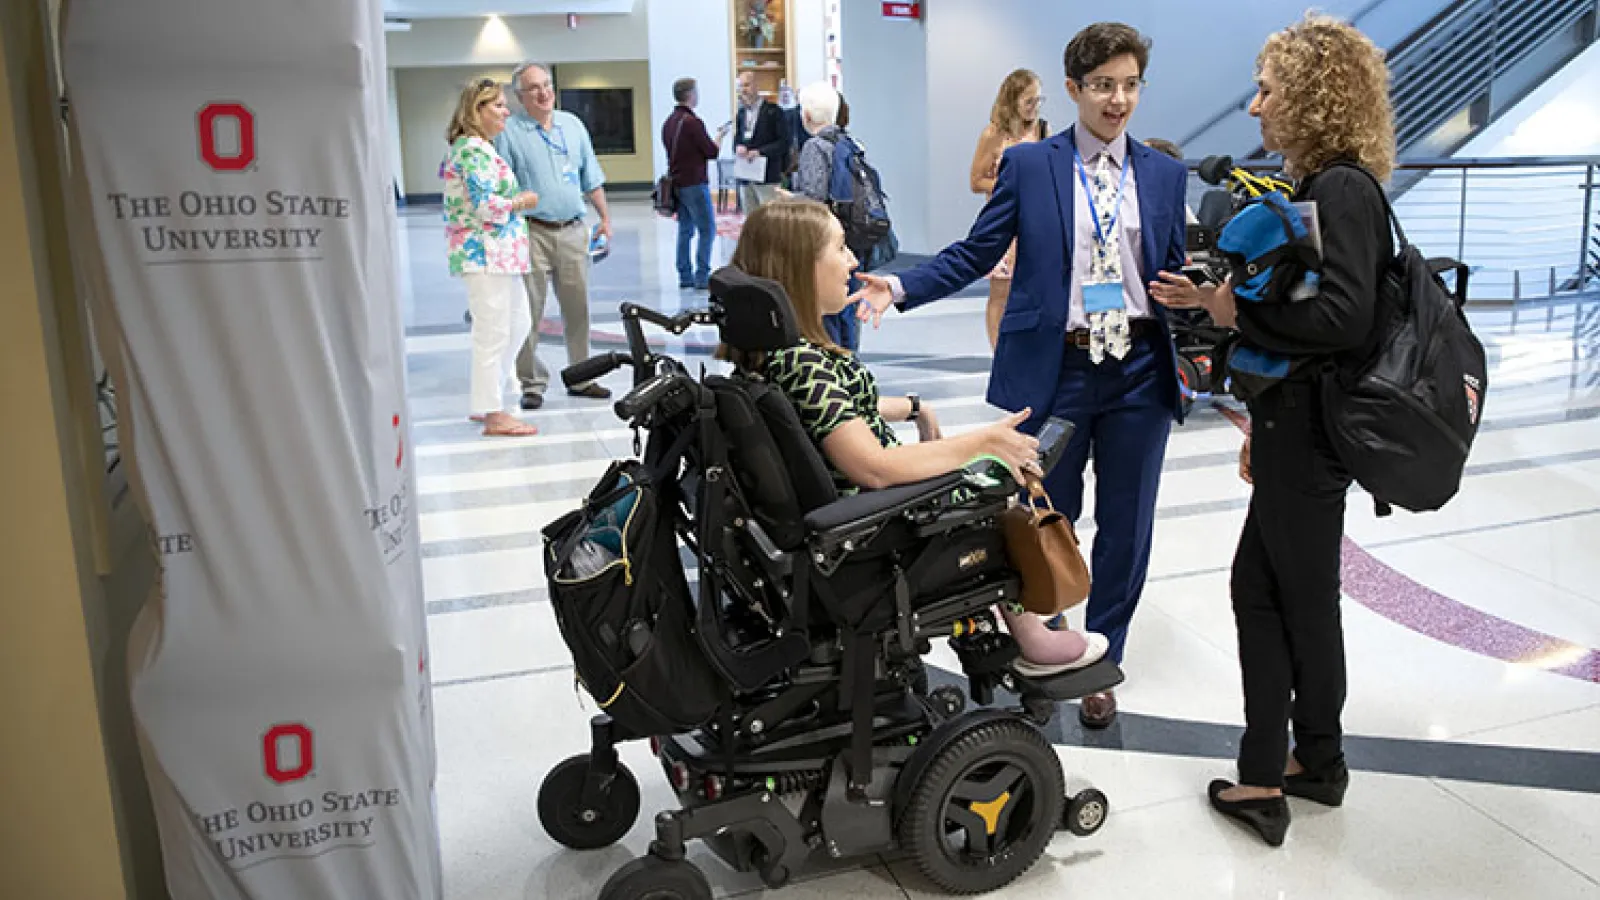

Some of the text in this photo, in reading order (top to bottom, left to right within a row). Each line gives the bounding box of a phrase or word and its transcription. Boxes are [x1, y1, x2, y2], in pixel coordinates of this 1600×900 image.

[197, 102, 255, 171] O
[107, 190, 349, 219] THE OHIO STATE
[143, 225, 322, 251] UNIVERSITY
[263, 722, 313, 783] O
[201, 788, 399, 835] HE OHIO STATE
[215, 816, 374, 861] UNIVERSITY
